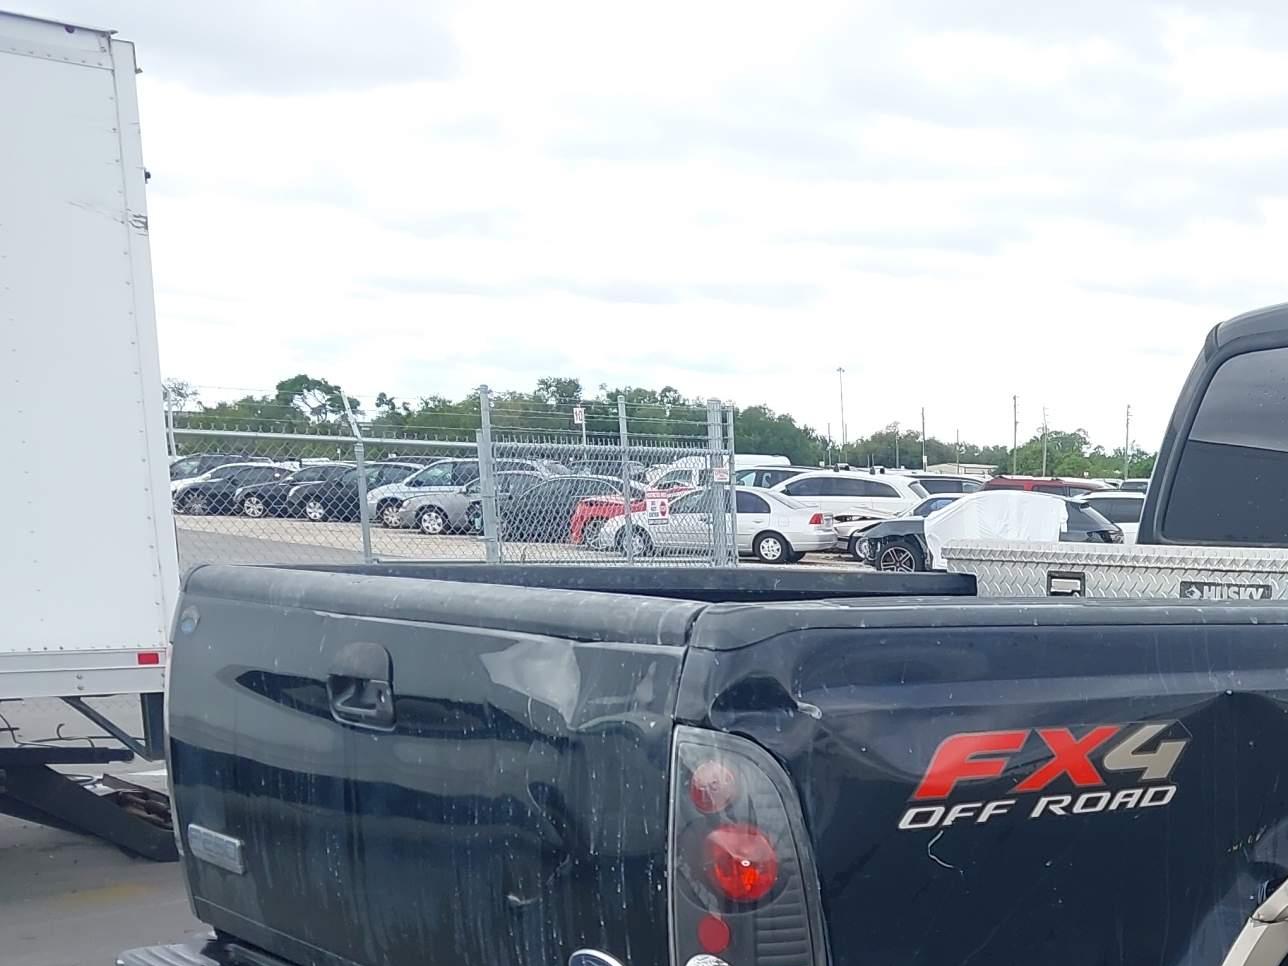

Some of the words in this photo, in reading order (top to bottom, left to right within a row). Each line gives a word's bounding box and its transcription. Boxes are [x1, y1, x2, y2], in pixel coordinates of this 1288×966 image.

[1203, 585, 1264, 600] HUSKY
[912, 724, 1188, 800] FX4
[898, 800, 1016, 829] OFF
[1029, 785, 1177, 818] ROAD
